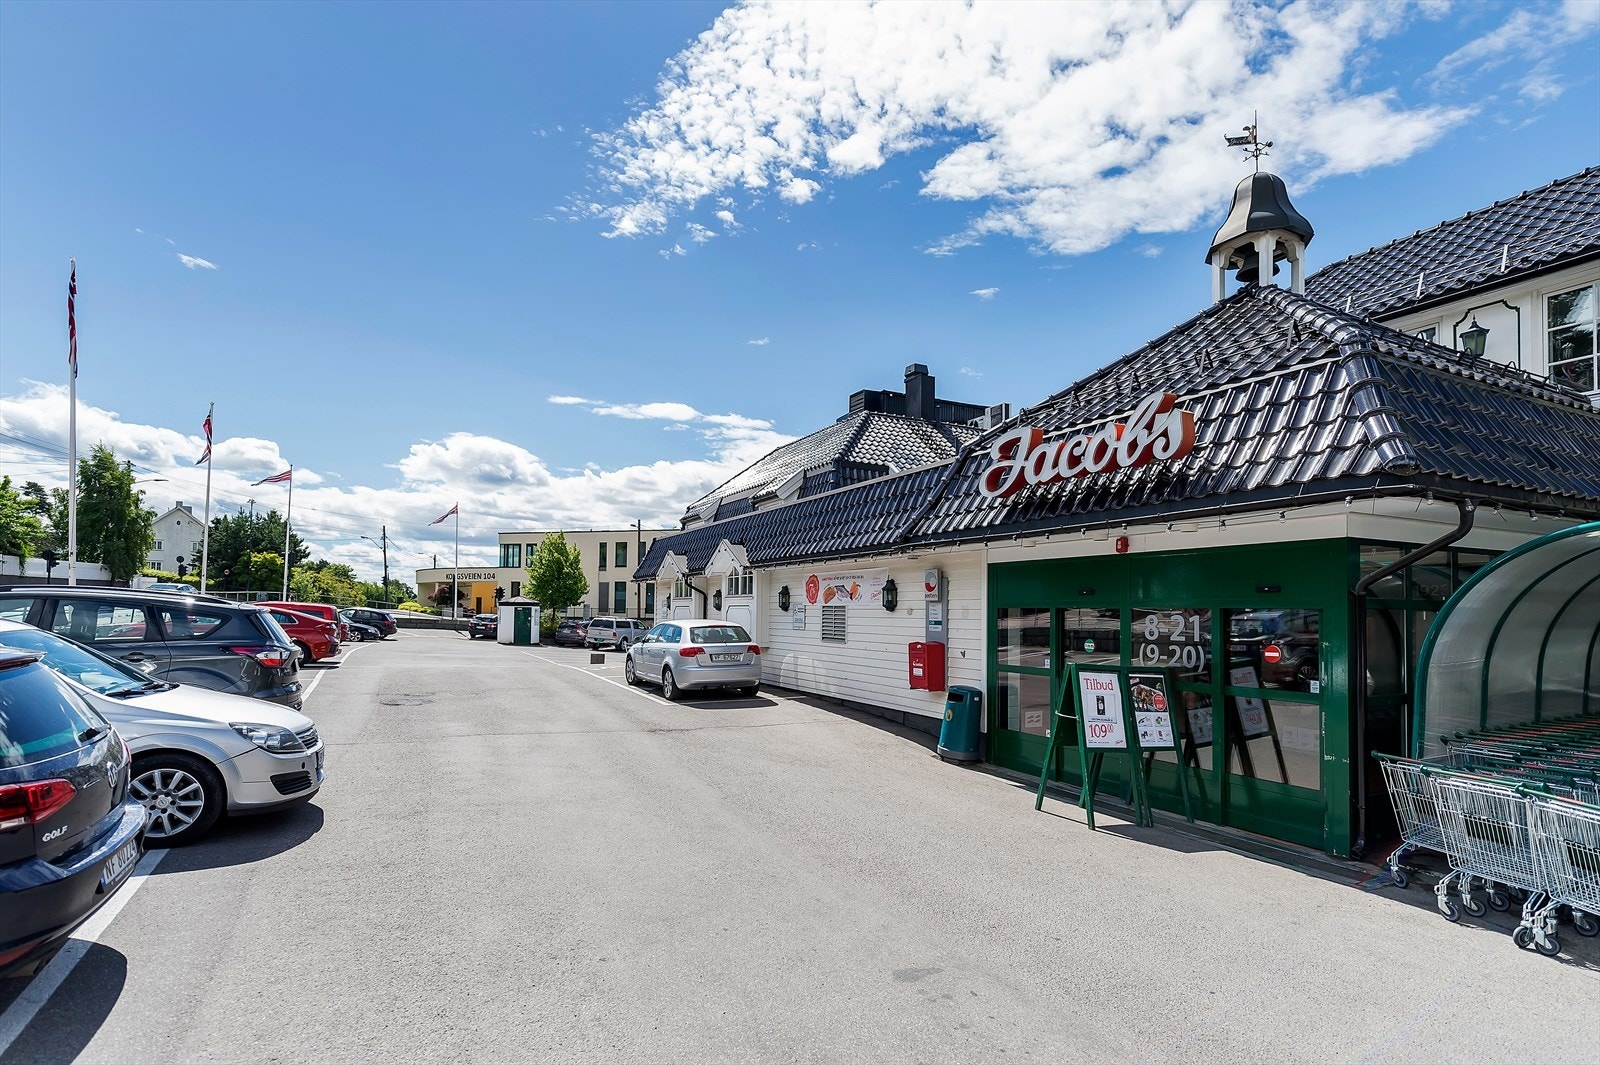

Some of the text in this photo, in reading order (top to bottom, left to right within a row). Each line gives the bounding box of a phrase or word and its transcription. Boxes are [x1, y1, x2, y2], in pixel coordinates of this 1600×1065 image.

[1145, 615, 1199, 641] 8-21
[1139, 643, 1205, 672] (9-20)
[1083, 678, 1114, 690] Tilbud
[42, 825, 68, 842] GOLF
[105, 858, 116, 880] NF
